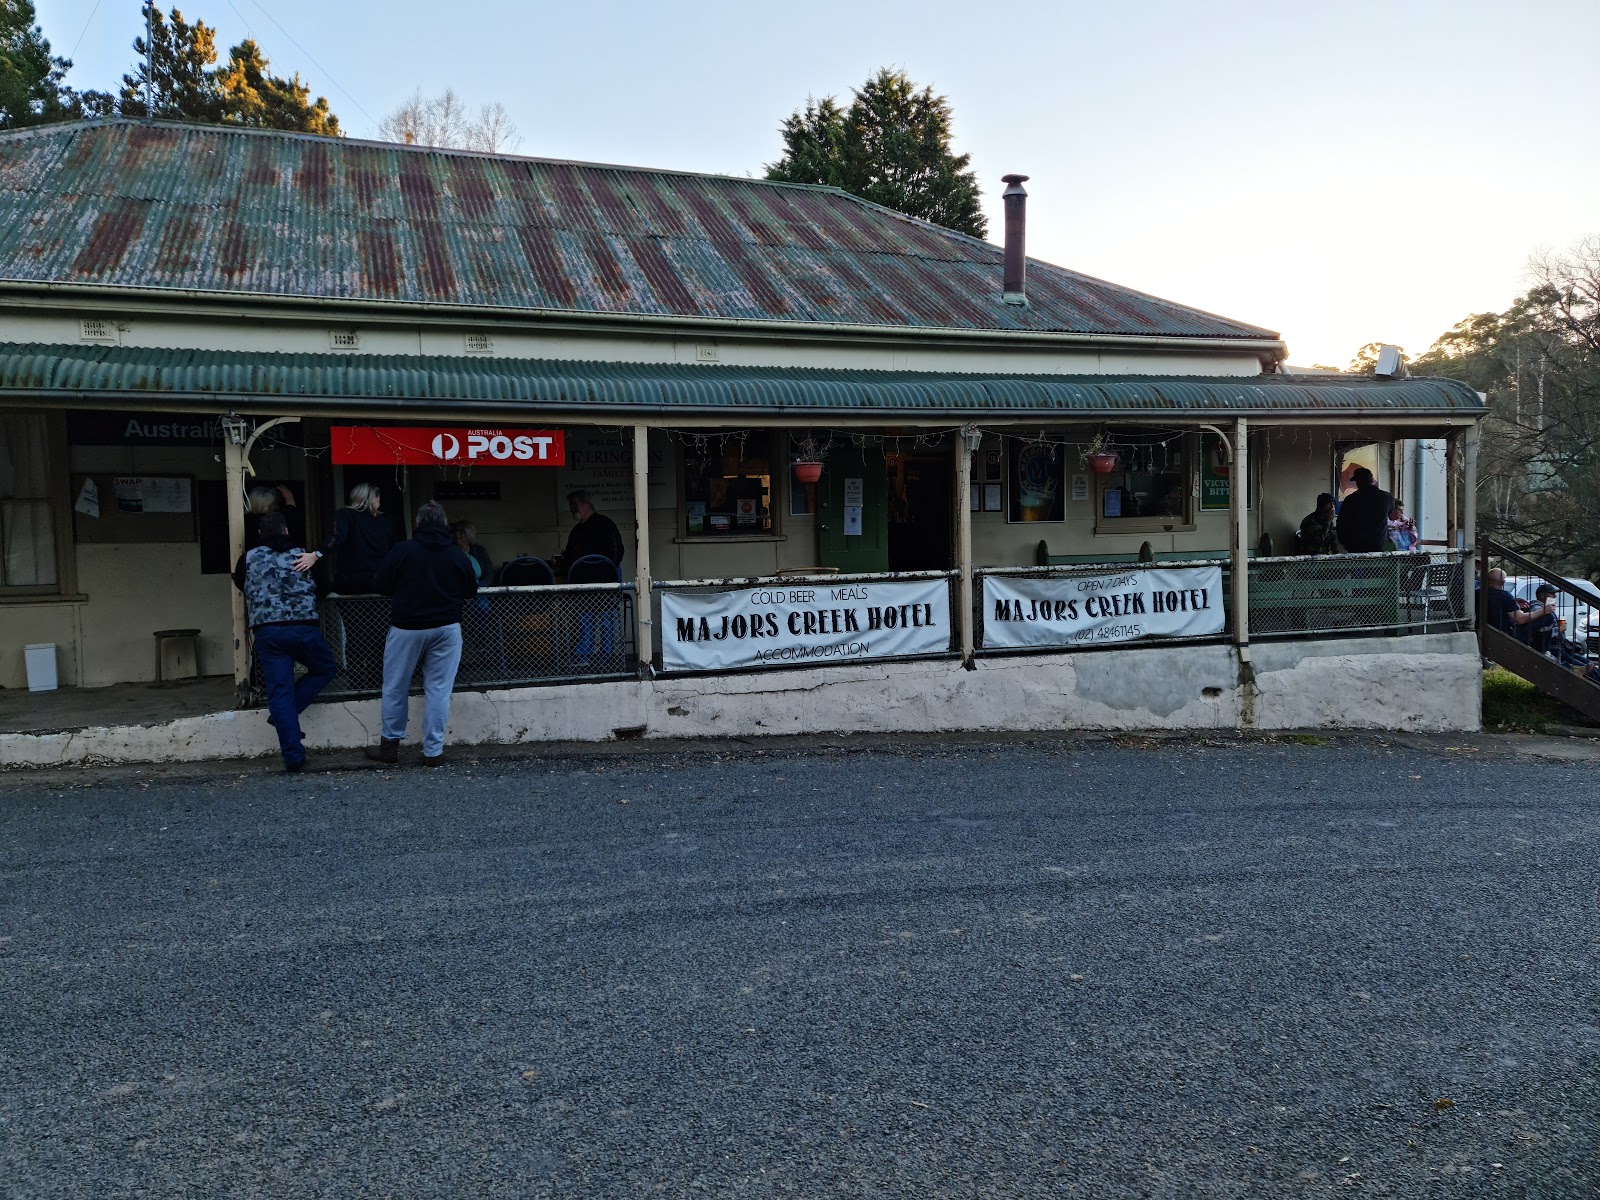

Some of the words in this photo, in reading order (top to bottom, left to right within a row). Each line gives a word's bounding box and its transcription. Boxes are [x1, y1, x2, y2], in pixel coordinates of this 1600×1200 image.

[124, 419, 225, 439] Australia
[467, 435, 553, 460] POST
[114, 478, 142, 486] SWAP
[592, 469, 624, 478] FAMILY
[1077, 580, 1105, 592] OPEN
[1106, 578, 1113, 588] 7
[1112, 575, 1138, 588] DAYS
[750, 591, 787, 606] COLD
[789, 590, 816, 603] BEER
[831, 587, 868, 602] MEALS
[994, 598, 1080, 622] MAJORS
[1085, 591, 1147, 619] CREEK
[1152, 588, 1212, 614] HOTEL
[676, 612, 780, 643] MAJORS
[787, 607, 861, 636] CREEK
[867, 603, 937, 632] HOTEL
[1074, 628, 1094, 642] (02)
[1097, 625, 1141, 639] 48461145
[753, 642, 870, 661] ACCOMMODATION
